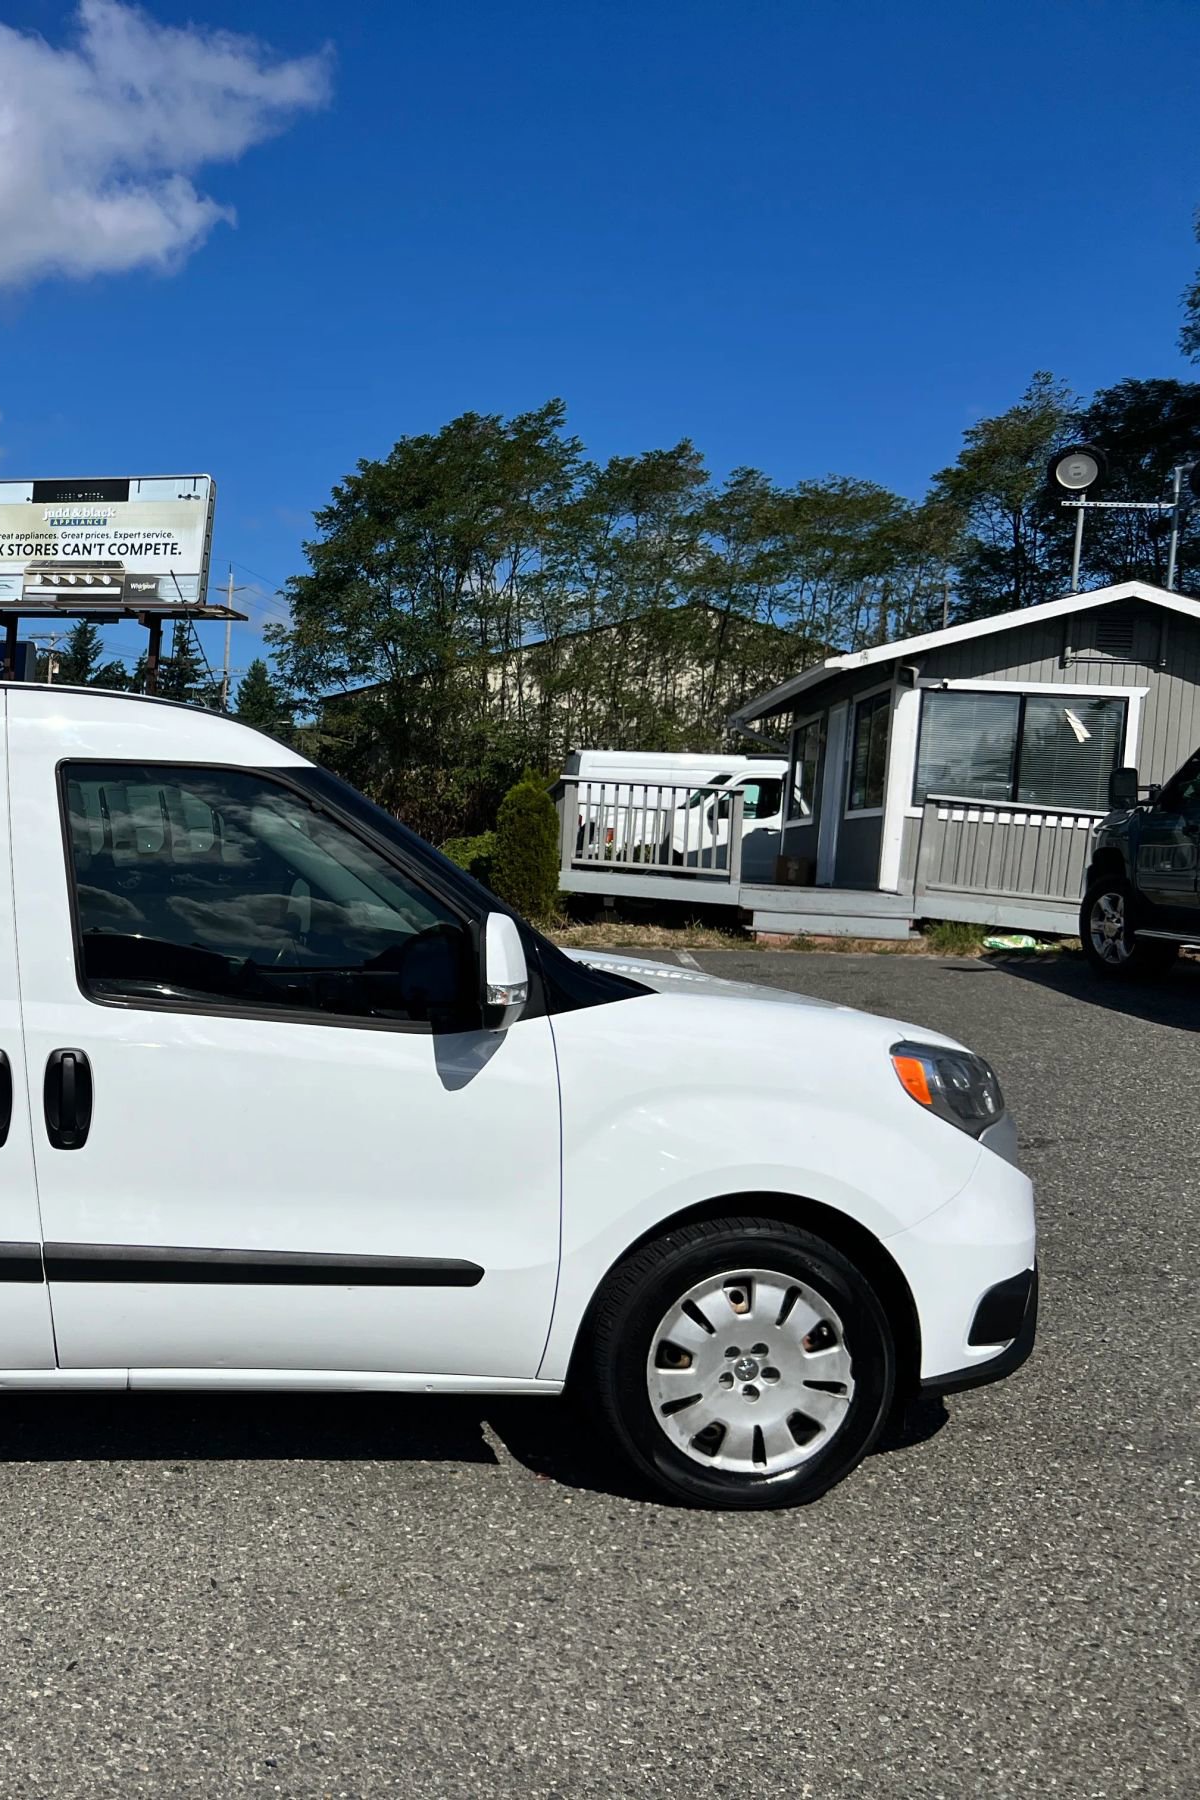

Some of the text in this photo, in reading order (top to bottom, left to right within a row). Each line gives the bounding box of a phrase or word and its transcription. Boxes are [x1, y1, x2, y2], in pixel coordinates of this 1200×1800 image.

[42, 507, 116, 521] judd & black
[52, 518, 105, 526] APPLIANCE
[15, 532, 59, 541] appliances.
[61, 531, 84, 540] Great
[85, 531, 111, 540] prices.
[114, 530, 141, 540] Expert
[143, 530, 174, 539] service.
[7, 543, 59, 556] STORES
[62, 542, 105, 556] CAN'T
[108, 542, 182, 556] COMPETE.
[130, 582, 156, 592] Whirlpool
